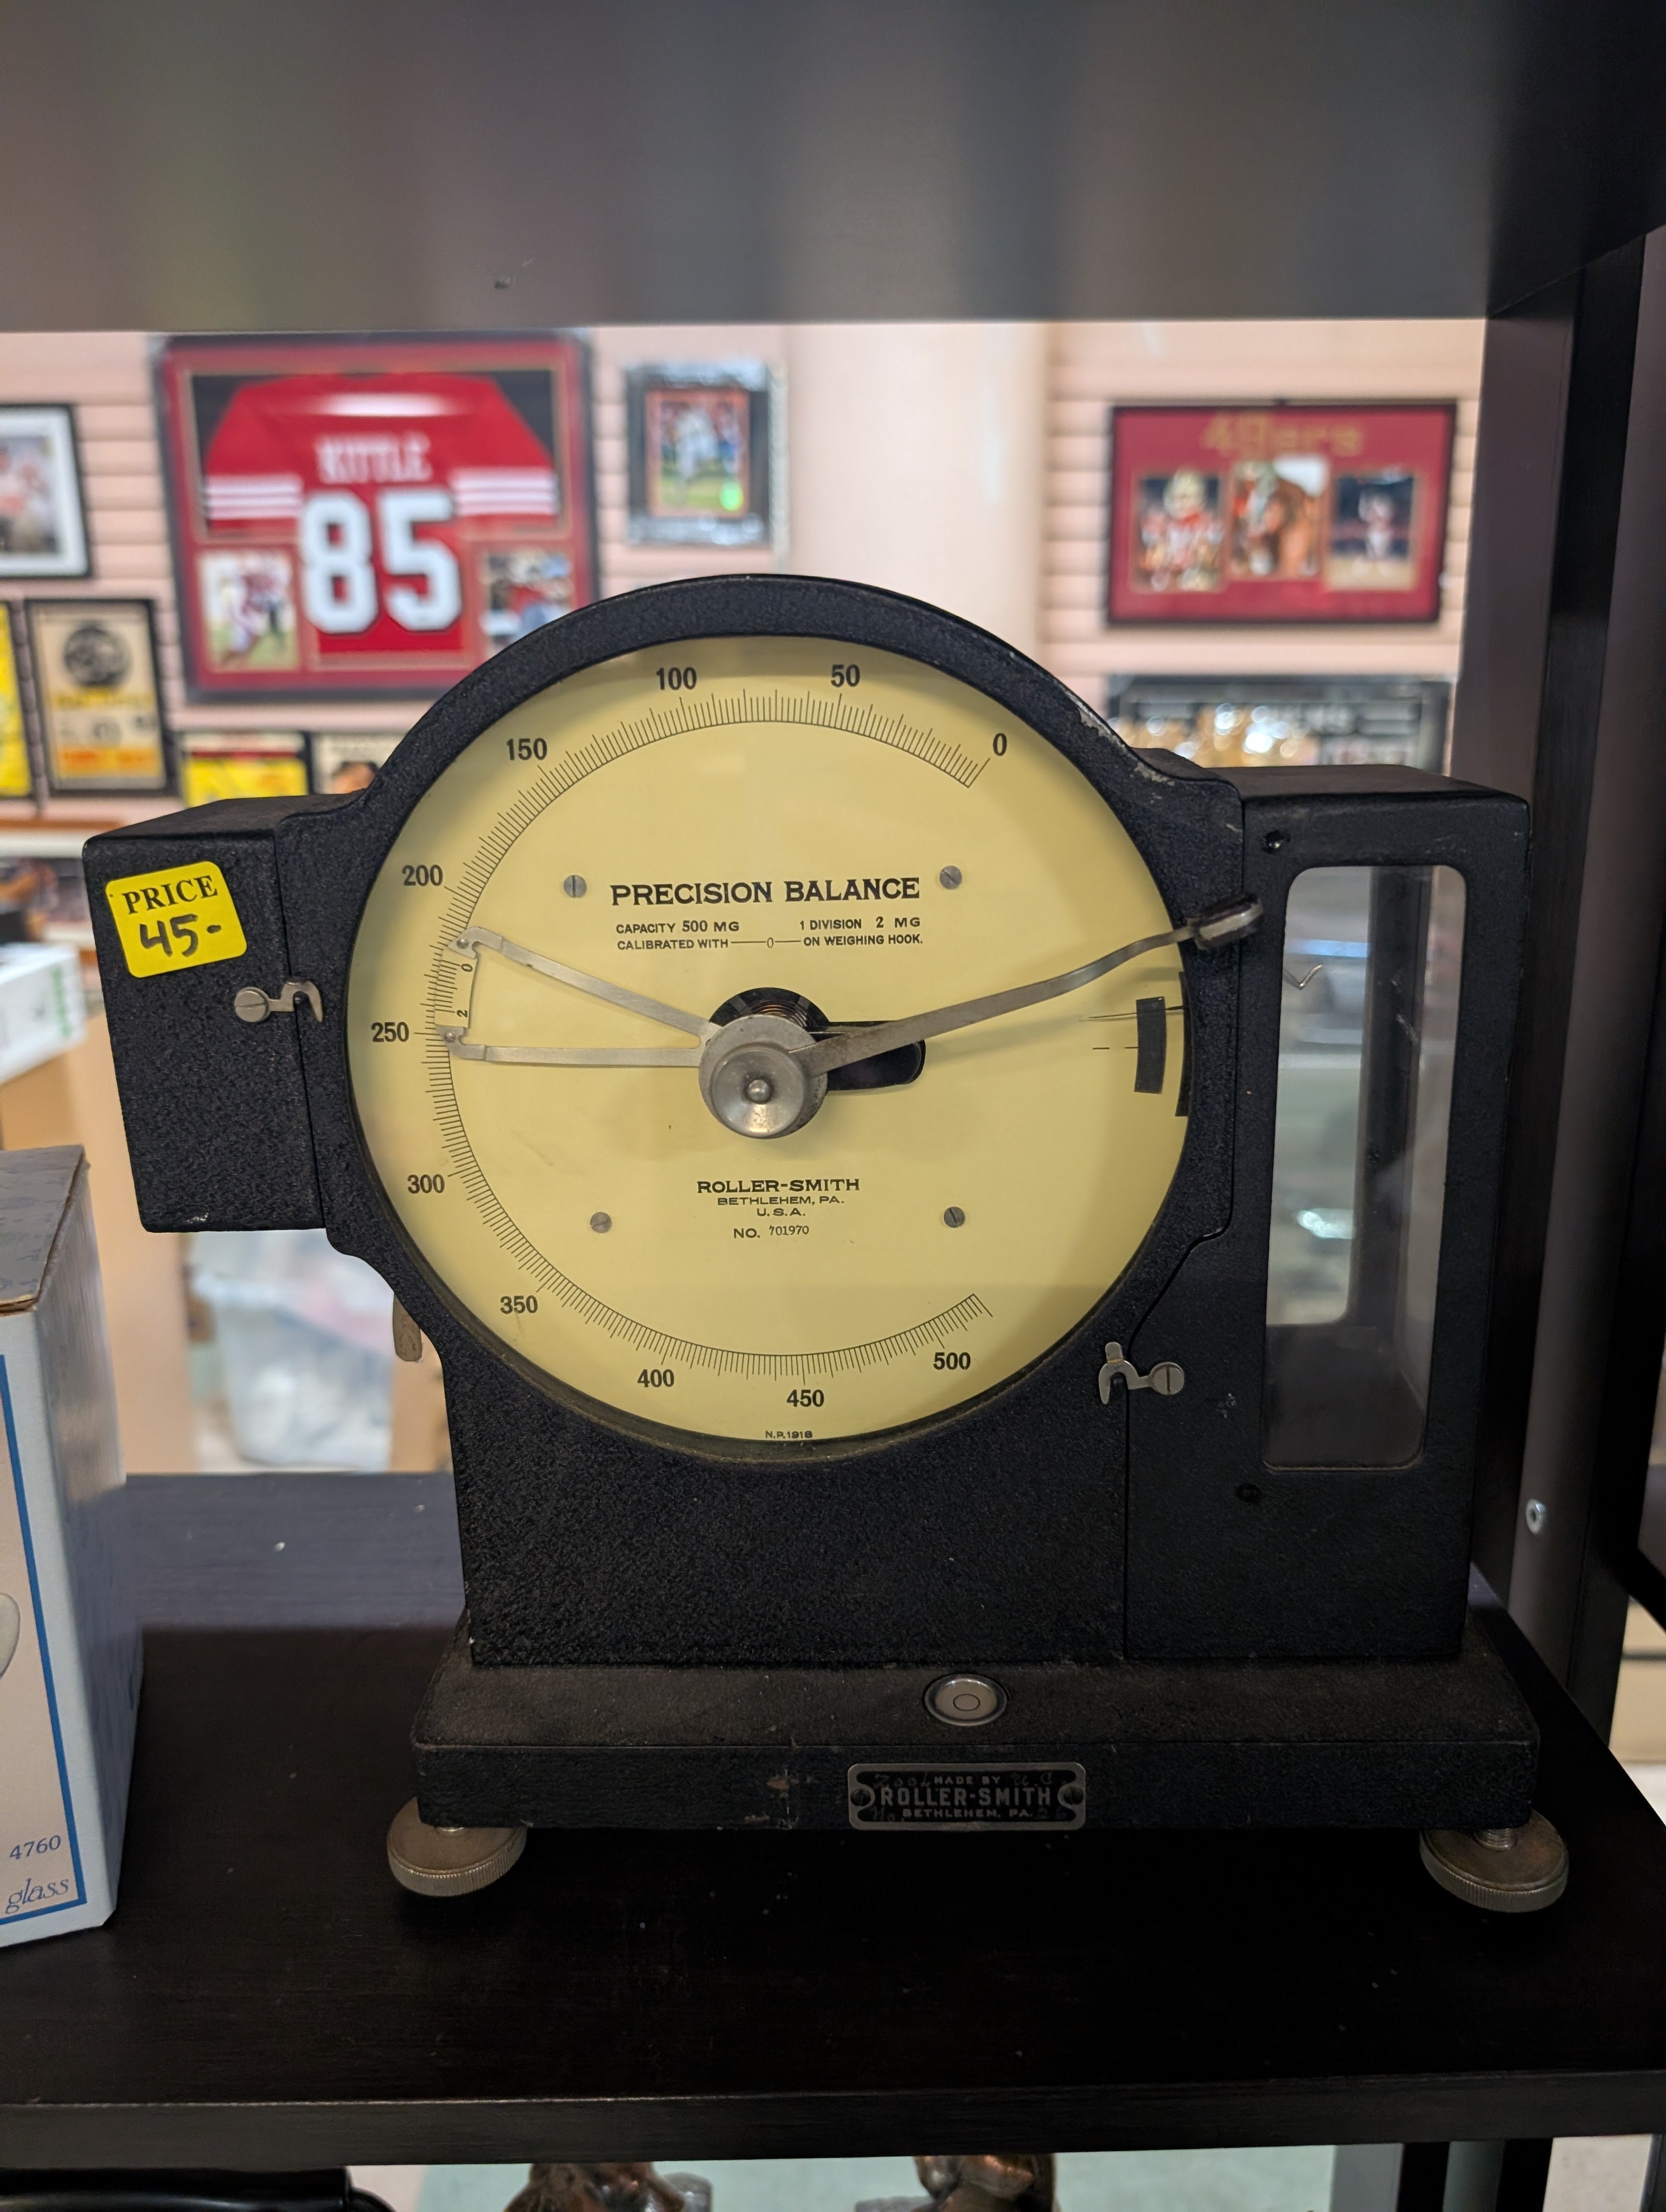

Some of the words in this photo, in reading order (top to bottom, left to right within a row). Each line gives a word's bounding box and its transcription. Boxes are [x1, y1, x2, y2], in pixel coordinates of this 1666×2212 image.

[299, 492, 463, 633] 85
[655, 666, 698, 691] 100
[830, 664, 861, 687] 50
[505, 737, 548, 761] 150
[992, 732, 1007, 757] 0
[402, 864, 443, 886] 200
[122, 875, 218, 915] PRICE
[610, 882, 773, 906] PRECISION
[783, 877, 920, 902] BALANCE
[616, 923, 676, 934] CAPACITY
[682, 920, 708, 933] 500
[714, 922, 740, 932] MG
[800, 920, 805, 930] 1
[810, 918, 862, 930] DIVISION
[875, 916, 884, 928] 2
[894, 917, 921, 928] MG
[617, 940, 694, 950] CALIBRATED
[697, 938, 729, 949] WITH
[803, 936, 820, 947] ON
[824, 935, 885, 946] WEIGHING
[888, 934, 923, 944] HOOK.
[460, 963, 473, 972] 0
[457, 1009, 468, 1018] 2
[371, 1022, 410, 1042] 250
[408, 1174, 445, 1194] 300
[697, 1178, 860, 1193] ROLLER-SMITH
[717, 1196, 815, 1206] BETHLEHEM,
[819, 1195, 845, 1204] PA.
[757, 1207, 806, 1217] U.S.A.
[733, 1228, 761, 1239] NO.
[769, 1225, 810, 1236] 701970
[500, 1295, 538, 1314] 350
[933, 1352, 971, 1370] 500
[637, 1369, 675, 1388] 400
[786, 1390, 825, 1408] 450
[934, 1776, 973, 1785] MADE
[982, 1776, 1001, 1785] BY
[881, 1787, 1051, 1806] ROLLER-SMITH
[10, 1835, 61, 1860] 4760
[5, 1877, 69, 1914] glass
